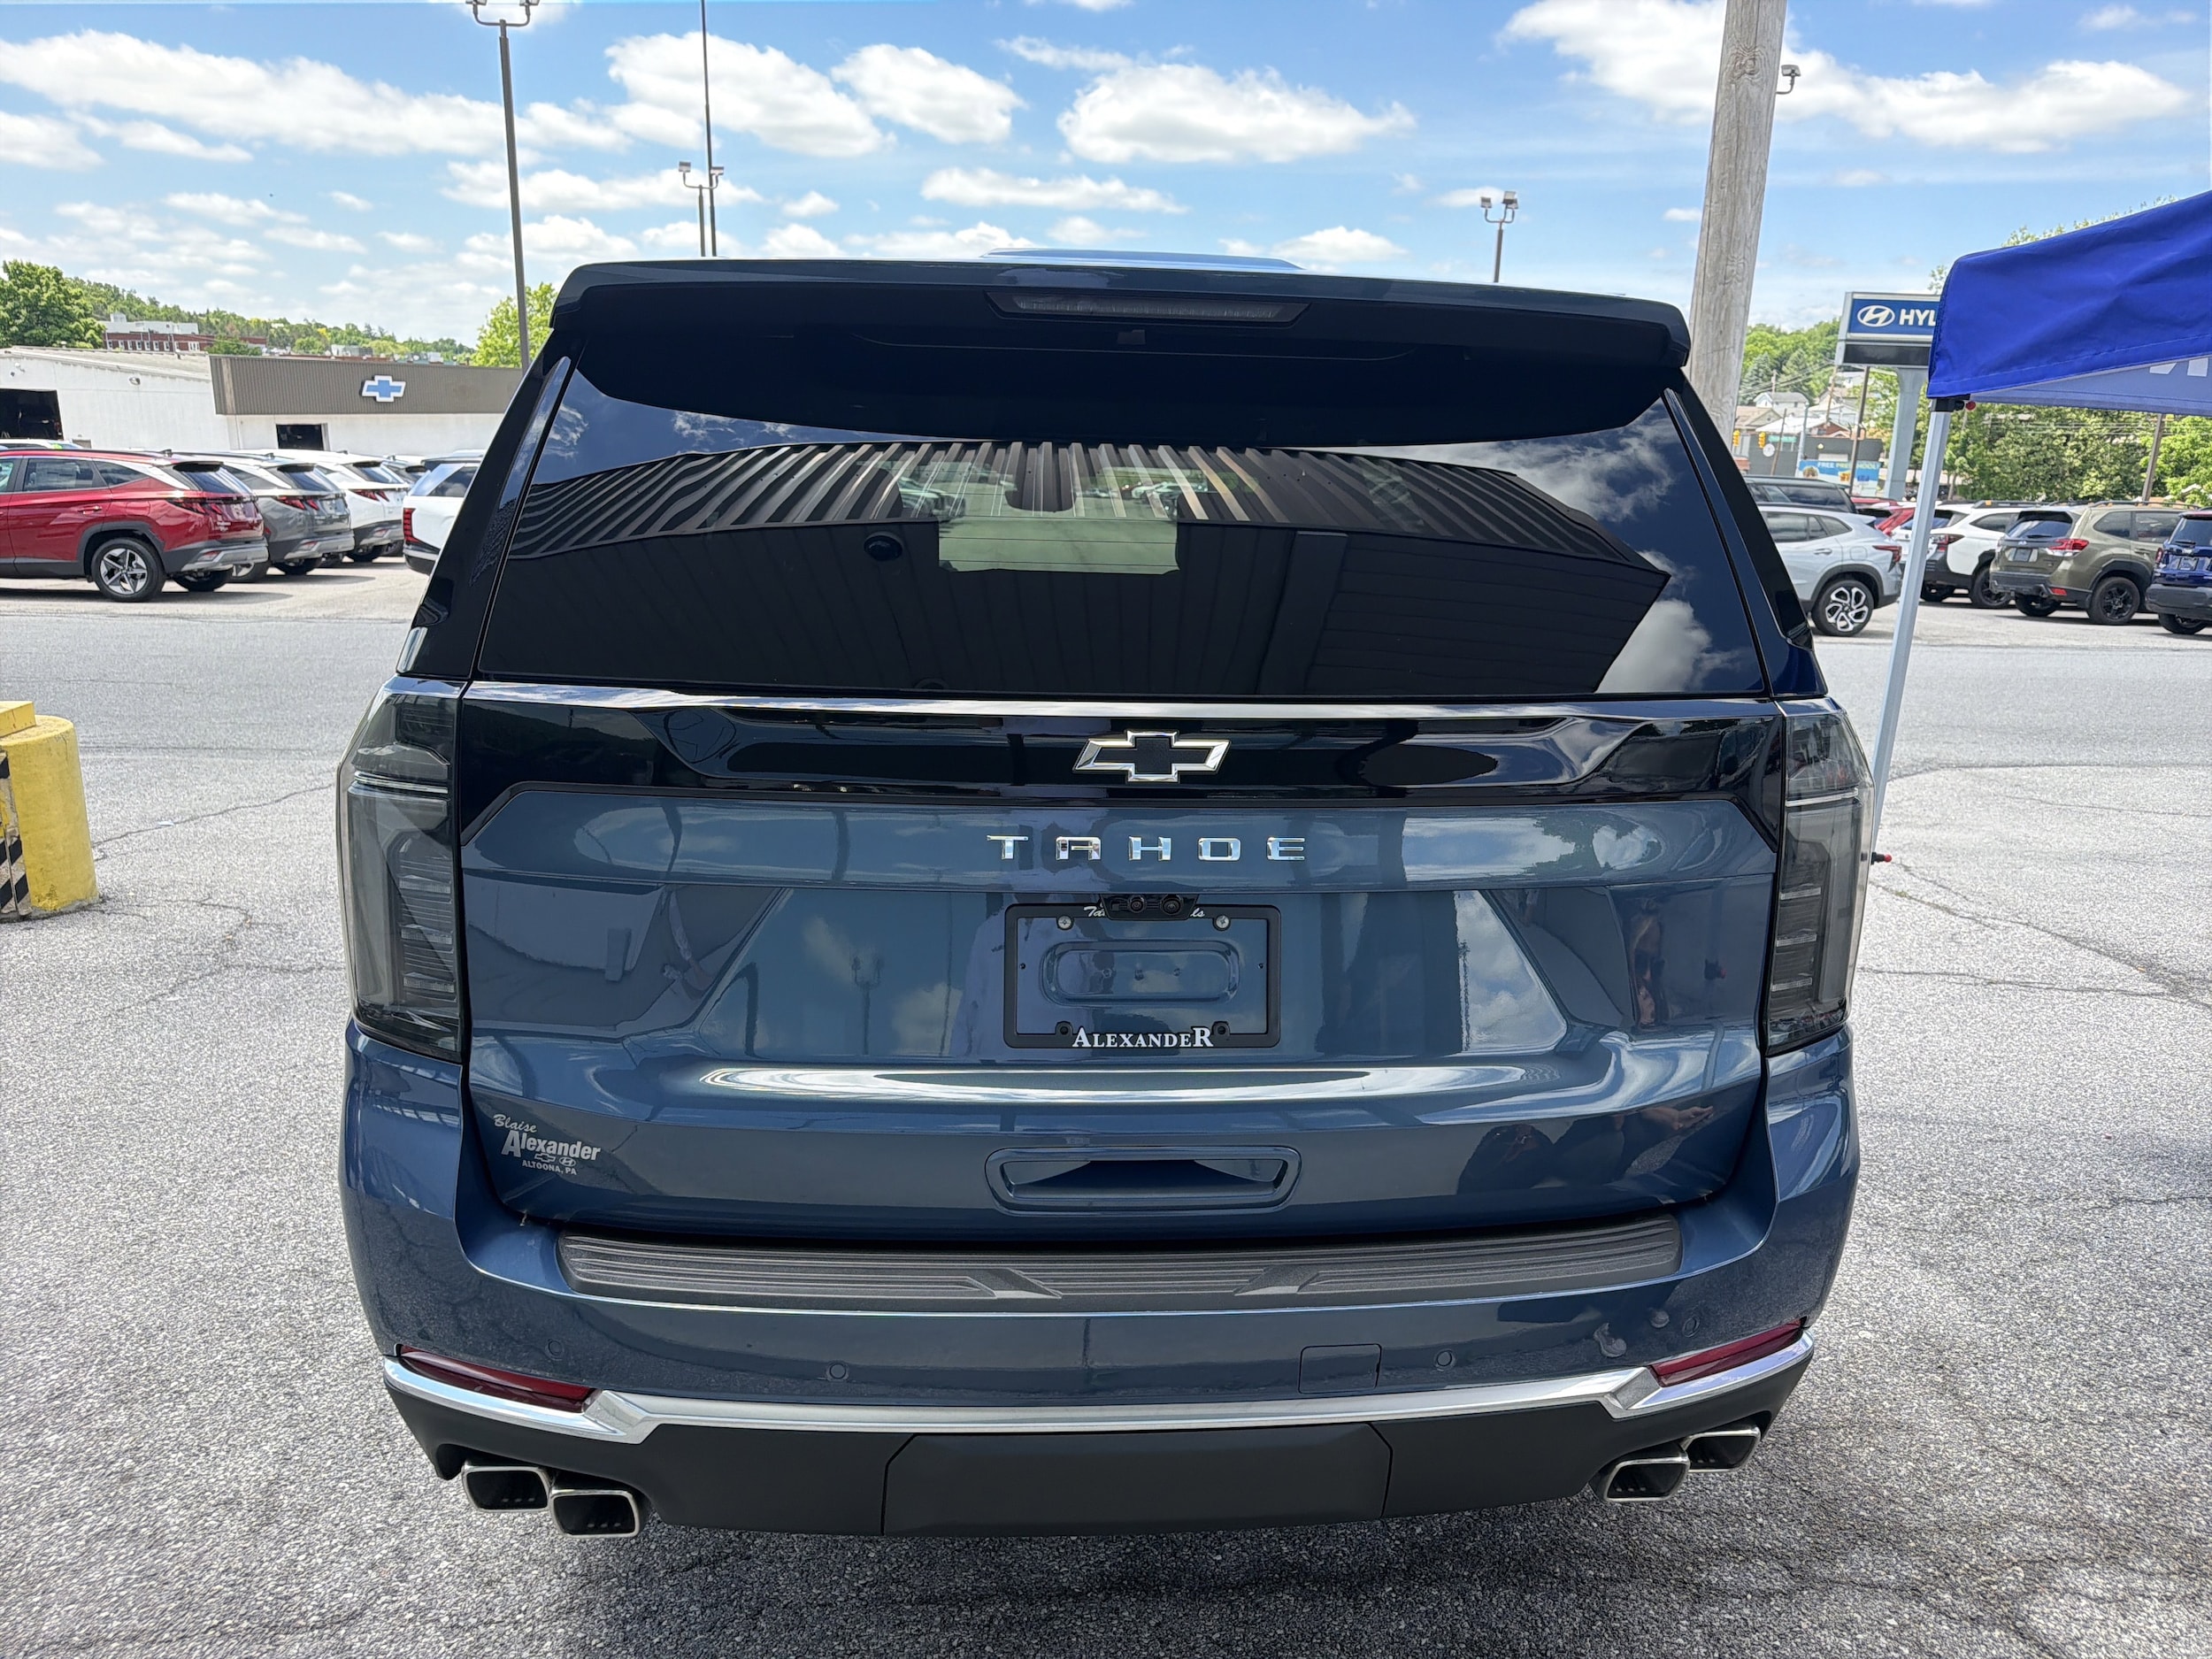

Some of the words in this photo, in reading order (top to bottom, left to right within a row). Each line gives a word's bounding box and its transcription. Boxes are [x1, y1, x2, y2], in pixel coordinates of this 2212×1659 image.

[987, 834, 1305, 861] TAHOE
[1071, 1026, 1214, 1048] ALEXANDER
[493, 1113, 537, 1133] Blaise
[501, 1129, 601, 1161] Alexander
[522, 1159, 564, 1174] ALTOONA,
[565, 1166, 577, 1175] PA
